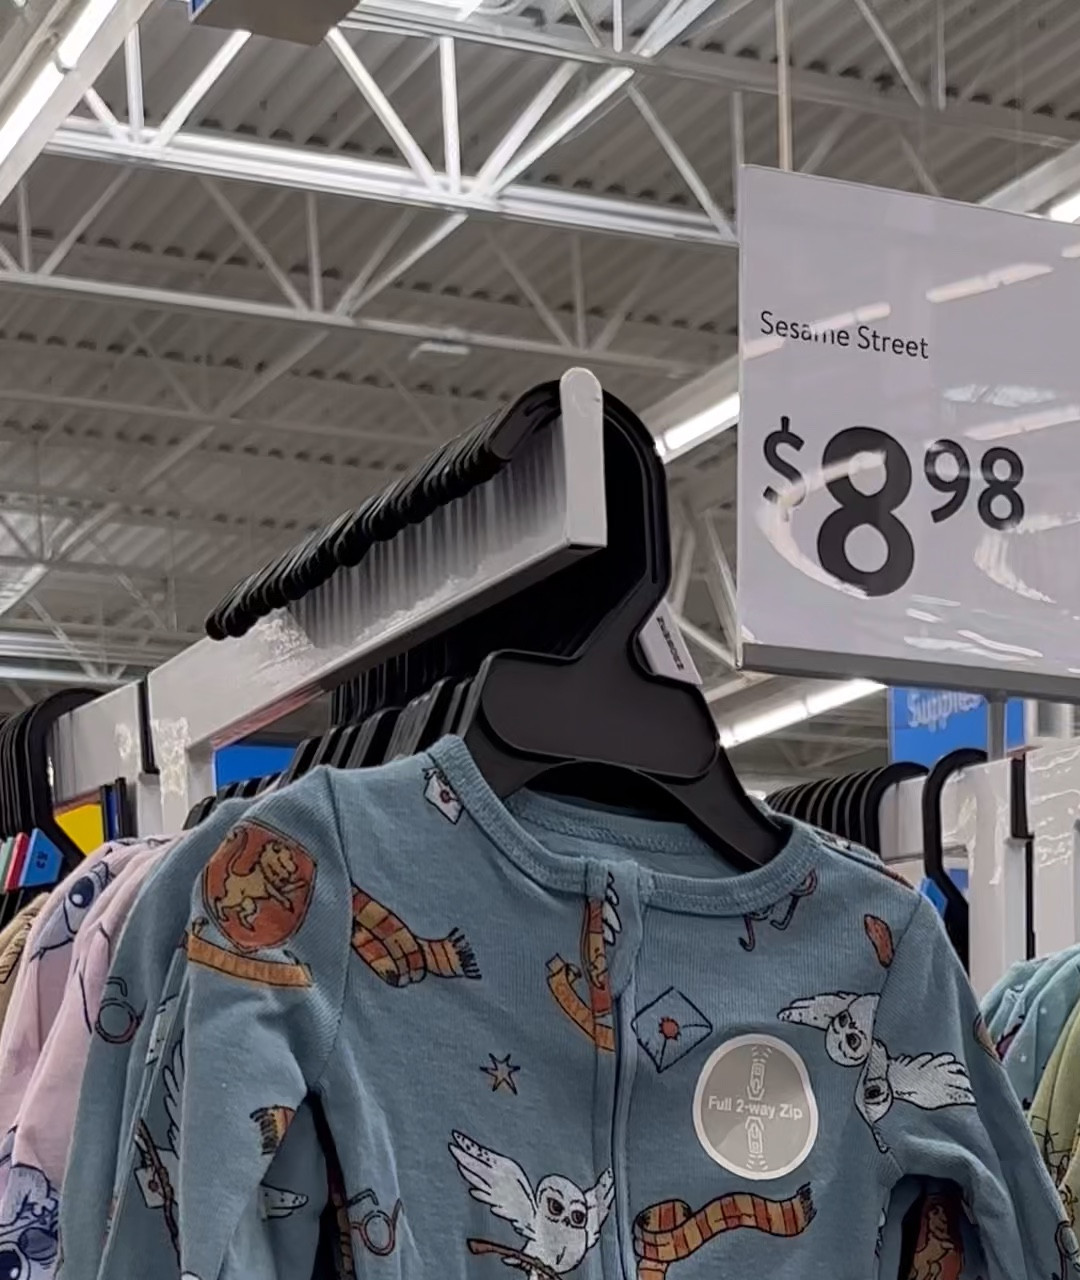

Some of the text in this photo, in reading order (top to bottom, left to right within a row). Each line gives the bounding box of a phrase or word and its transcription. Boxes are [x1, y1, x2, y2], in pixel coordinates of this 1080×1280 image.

[760, 310, 930, 360] Sesame Street
[707, 1095, 803, 1120] Full 2-way Zip
